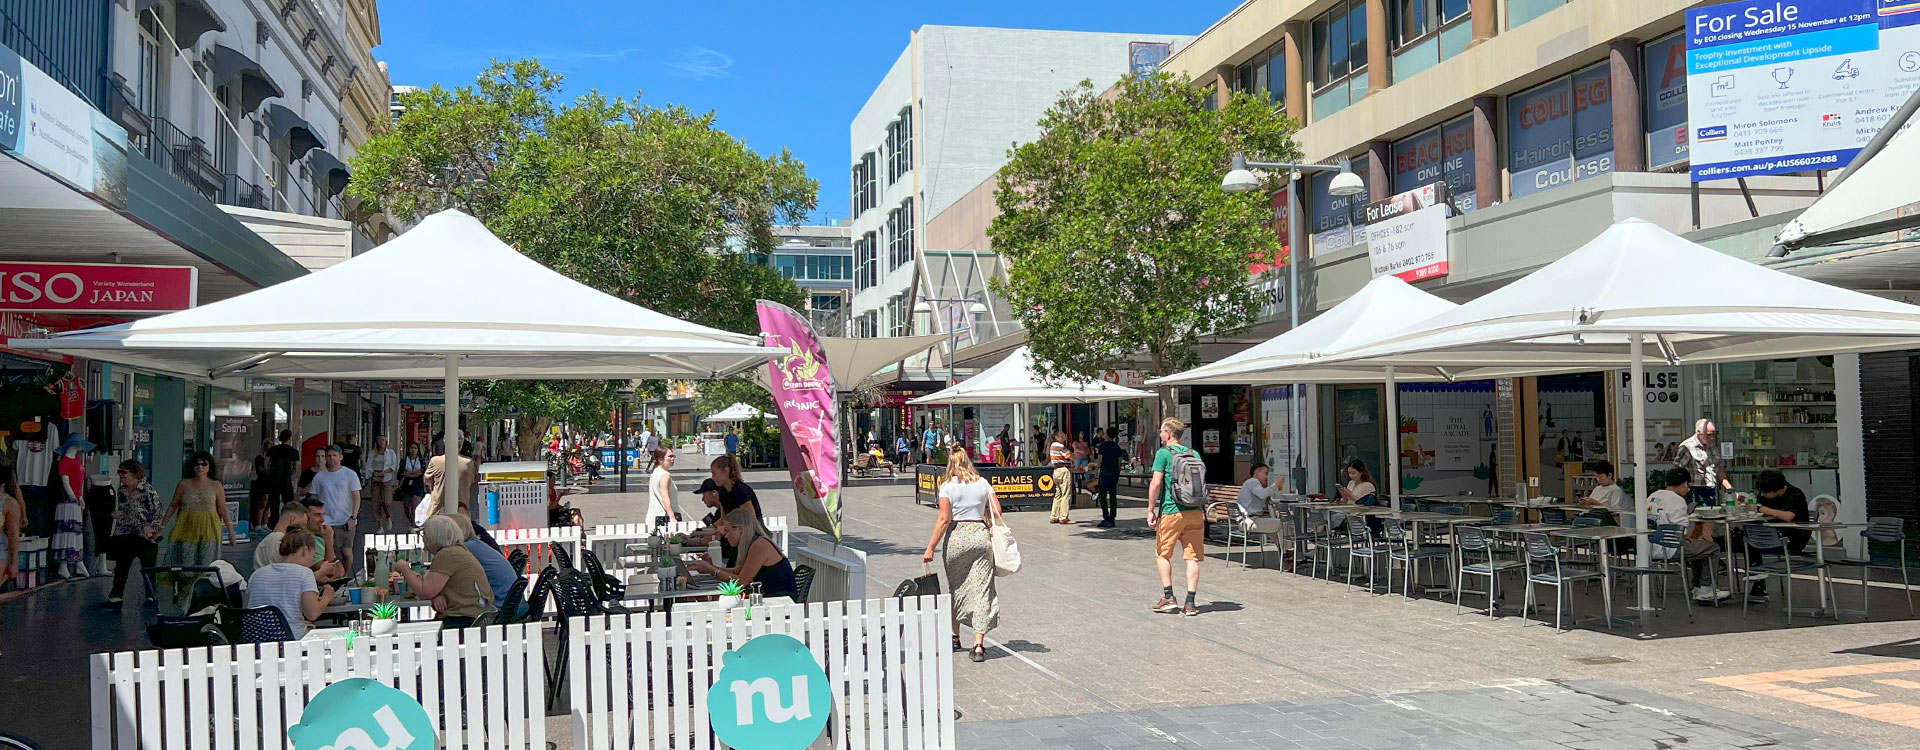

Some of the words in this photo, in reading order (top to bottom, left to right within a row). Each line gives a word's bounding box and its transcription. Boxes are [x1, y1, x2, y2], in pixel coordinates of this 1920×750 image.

[1695, 14, 1737, 35] For
[1744, 2, 1798, 28] Sale
[1704, 35, 1716, 43] EOI
[1717, 32, 1743, 40] closing
[1743, 25, 1786, 37] Wednesday
[1798, 17, 1837, 29] November
[1849, 13, 1871, 22] 12pm
[1695, 51, 1723, 61] Trophy
[1725, 44, 1771, 56] Investment
[1773, 41, 1792, 50] with
[1695, 57, 1742, 70] Exceptional
[1744, 49, 1800, 63] Development
[1802, 44, 1832, 55] Upside
[1520, 76, 1612, 129] COLLEG
[1855, 107, 1888, 116] Andrew
[1734, 122, 1757, 130] Miron
[1758, 117, 1798, 127] Solomons
[1855, 115, 1875, 124] 0418
[1699, 128, 1725, 137] Colliers
[1734, 140, 1753, 148] Matt
[1755, 138, 1783, 147] Pontey
[1417, 156, 1464, 182] ONLINE
[1535, 156, 1611, 189] Course
[1698, 154, 1838, 176] colliers.com.au/p-AUS66022488
[1331, 190, 1368, 211] ONLINE
[1366, 206, 1379, 222] For
[1380, 200, 1404, 218] Lease
[93, 280, 116, 288] Variety
[90, 290, 155, 304] JAPAN
[1622, 372, 1678, 388] PLSE
[222, 423, 247, 433] Sauna
[991, 475, 1033, 484] FLAMES
[730, 675, 812, 726] nu
